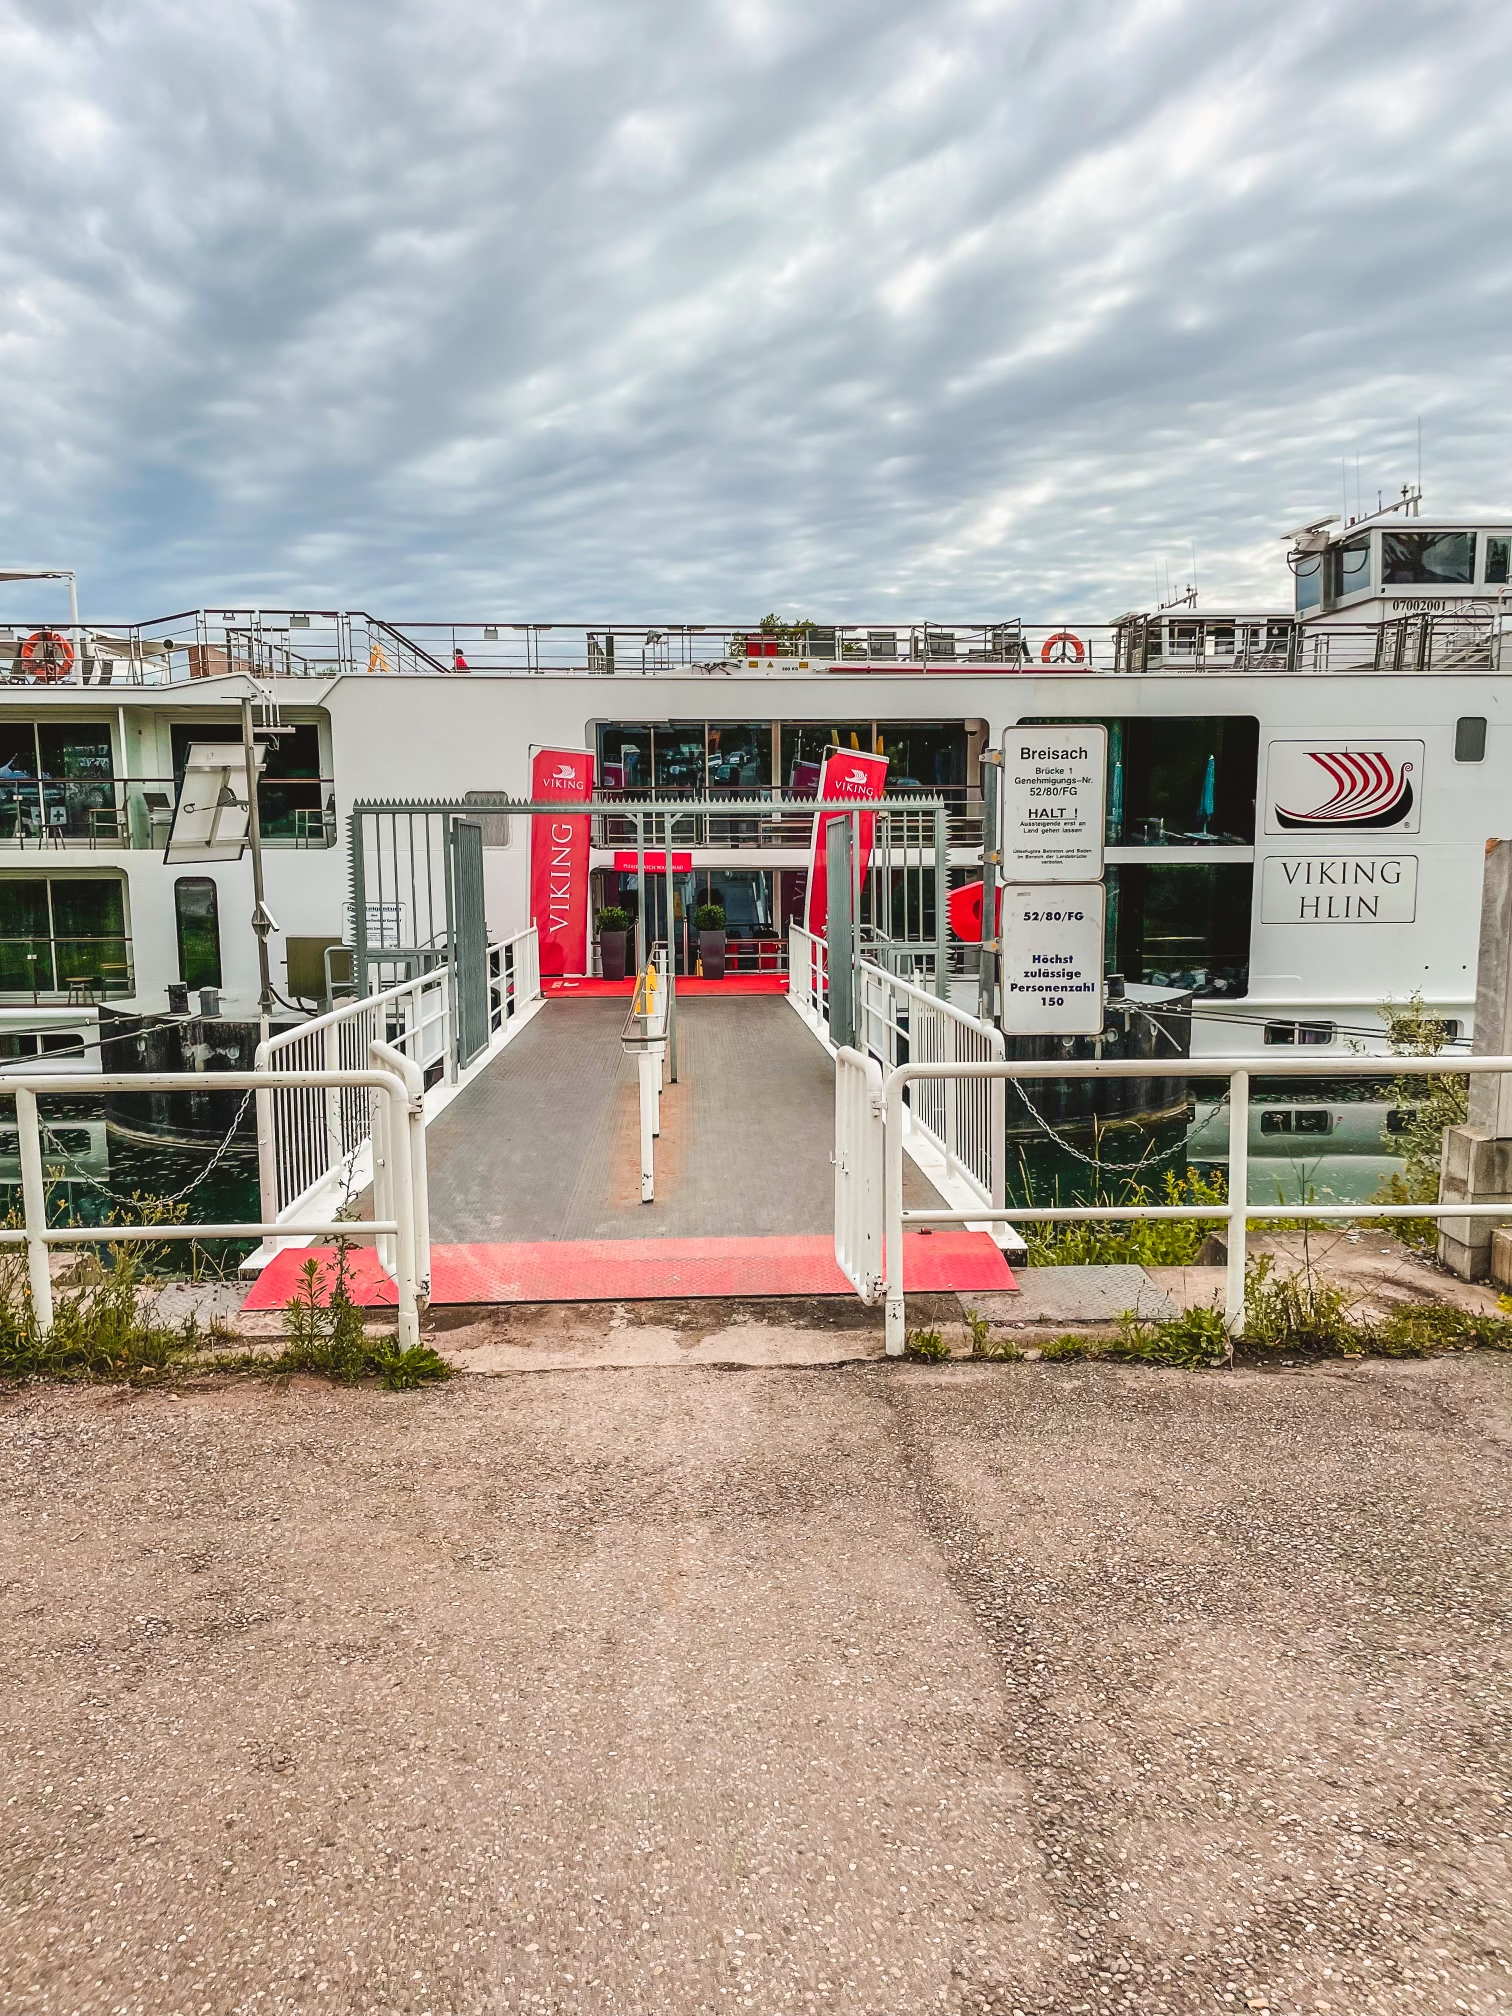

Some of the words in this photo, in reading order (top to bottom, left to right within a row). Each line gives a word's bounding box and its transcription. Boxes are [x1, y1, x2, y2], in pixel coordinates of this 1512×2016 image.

[1392, 600, 1446, 611] 07002001
[1020, 747, 1088, 760] Breisach
[1035, 767, 1065, 775] Brücke
[543, 778, 584, 790] VIKING
[1014, 776, 1093, 786] Genehmigungs-Nr.
[835, 780, 874, 796] VIKING
[1029, 787, 1078, 796] 52/80/FG
[1028, 808, 1067, 818] HALT
[1074, 808, 1078, 818] !
[549, 823, 574, 934] VIKING
[1281, 861, 1401, 885] VIKING
[1298, 896, 1380, 919] HLIN
[1023, 911, 1084, 922] 52/80/FG
[1032, 954, 1074, 964] Höchst
[1023, 968, 1082, 980] zulässige
[1010, 982, 1095, 992] Personenzahl
[1041, 997, 1065, 1007] 150
